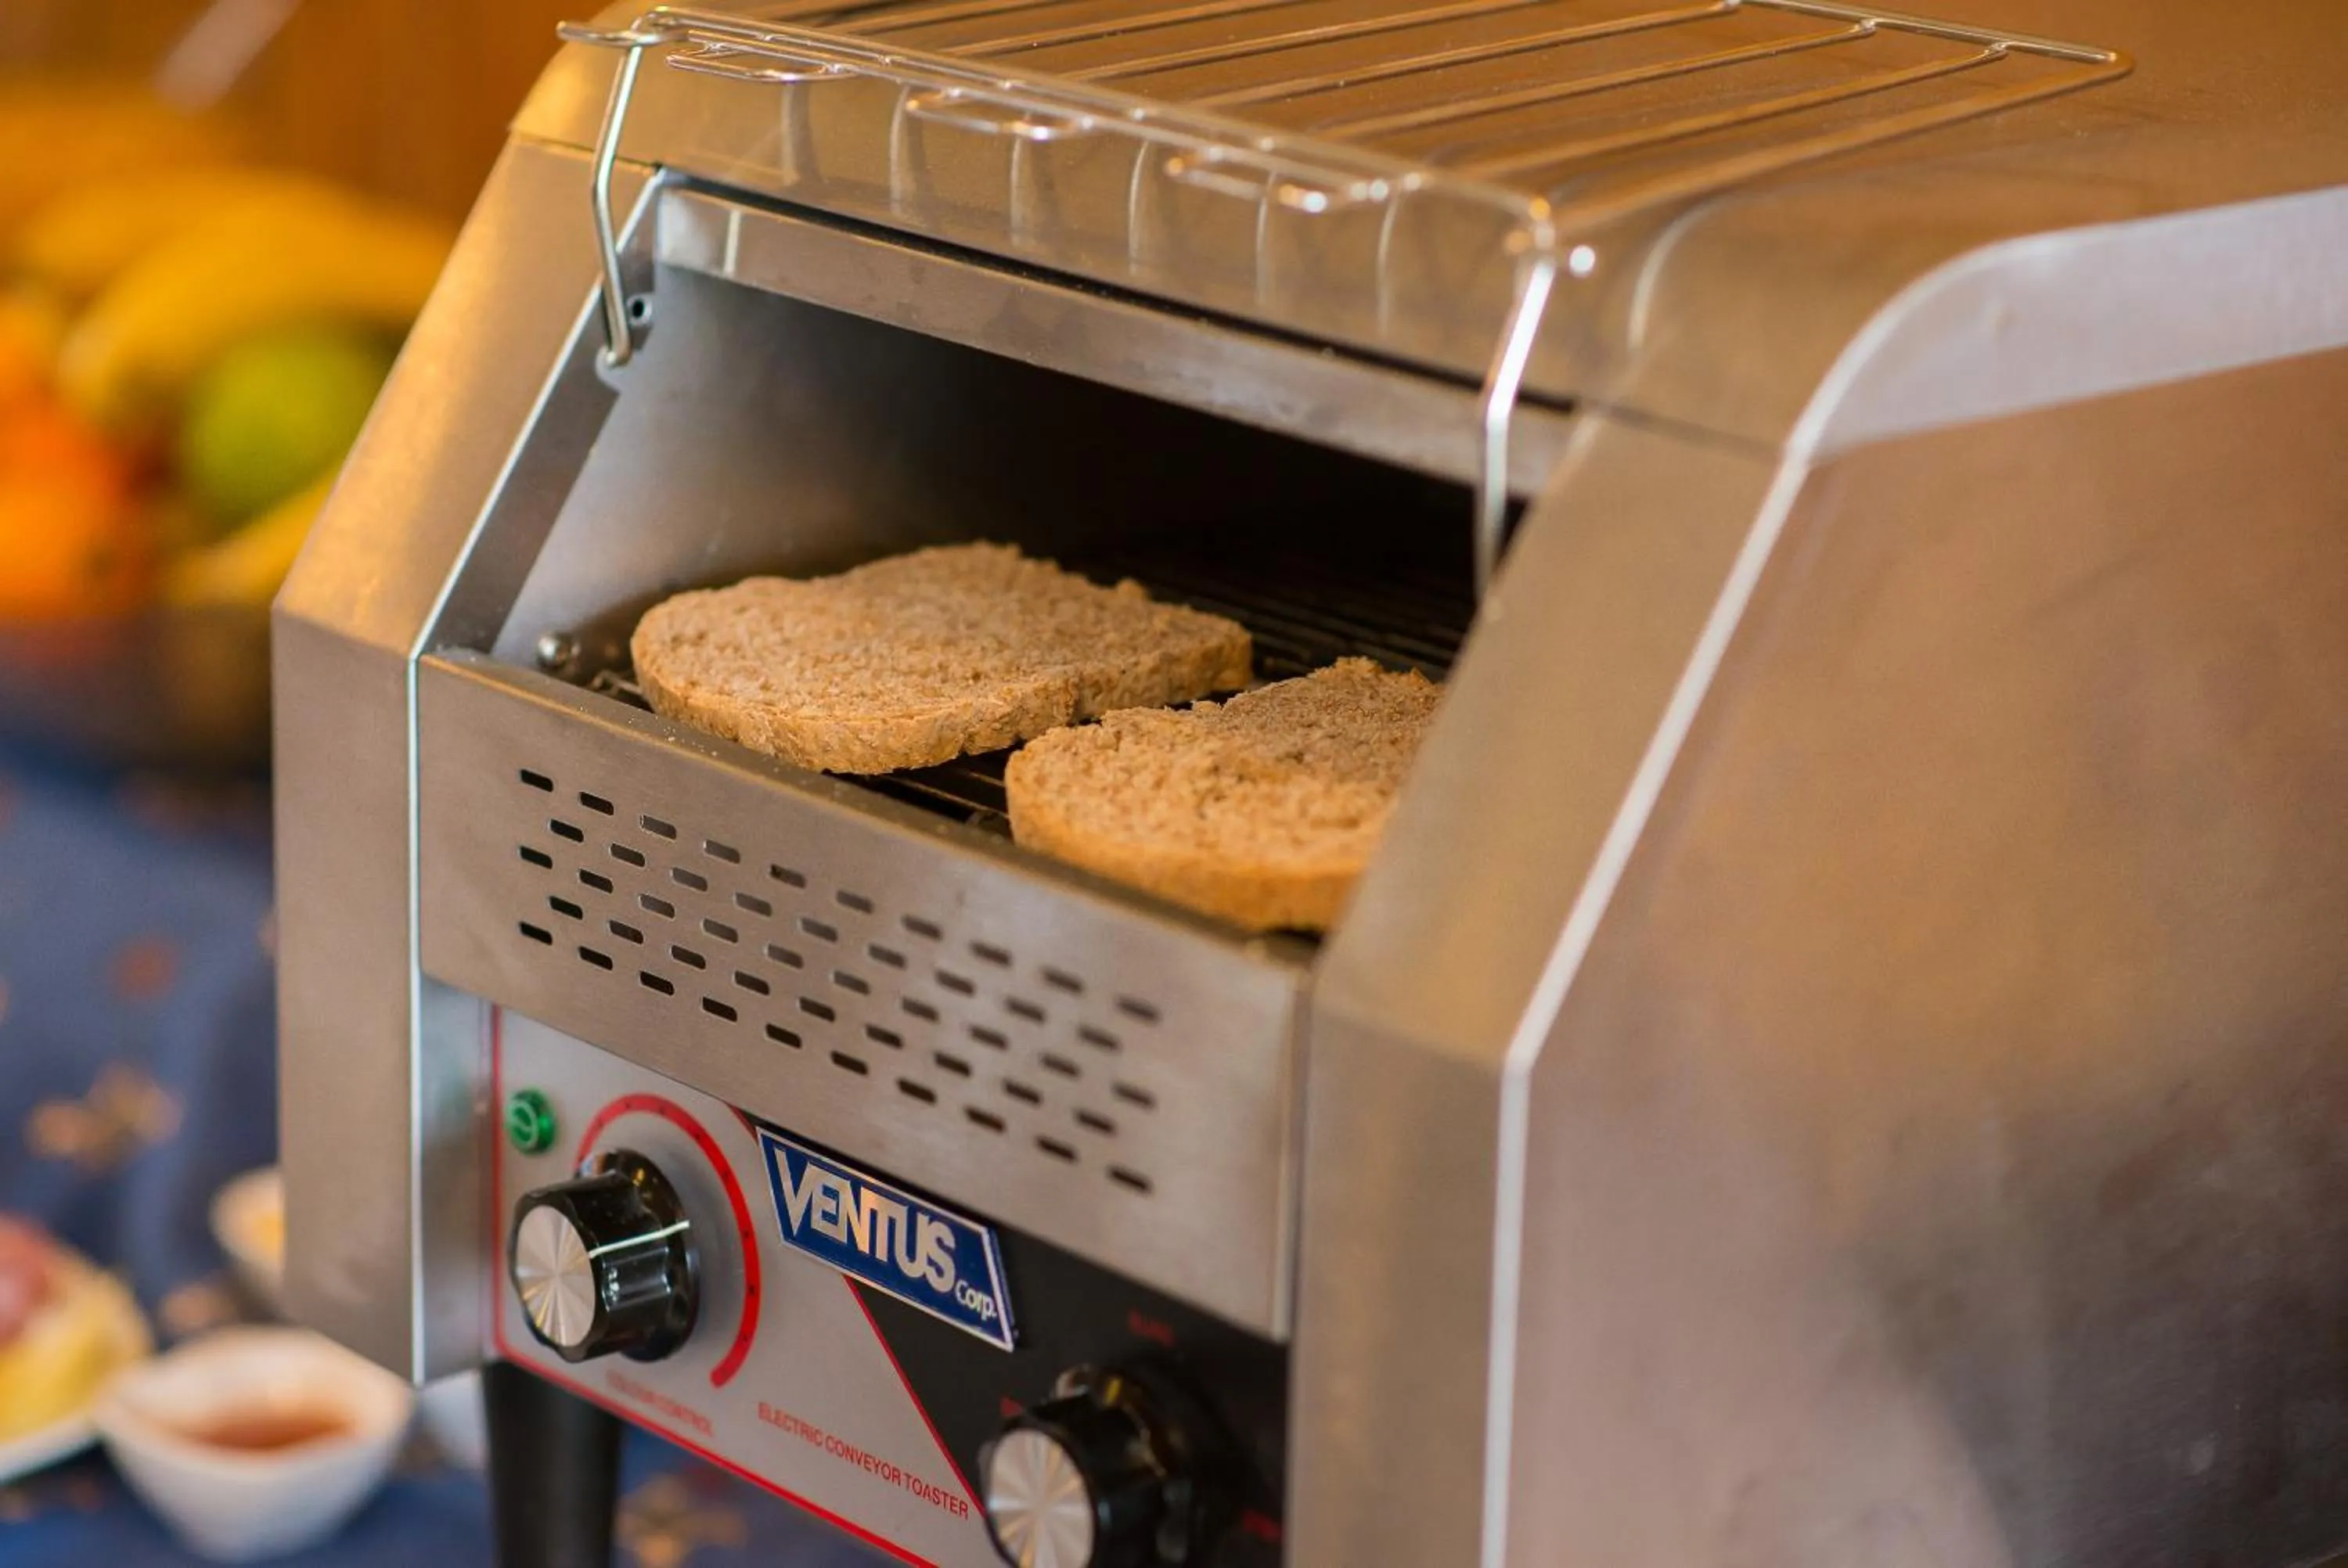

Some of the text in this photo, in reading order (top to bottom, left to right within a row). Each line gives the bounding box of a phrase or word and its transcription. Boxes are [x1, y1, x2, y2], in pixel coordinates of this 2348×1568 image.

[774, 1146, 956, 1293] VENTUS
[758, 1401, 969, 1521] ELECTRIC CONVEYOR TOASTER
